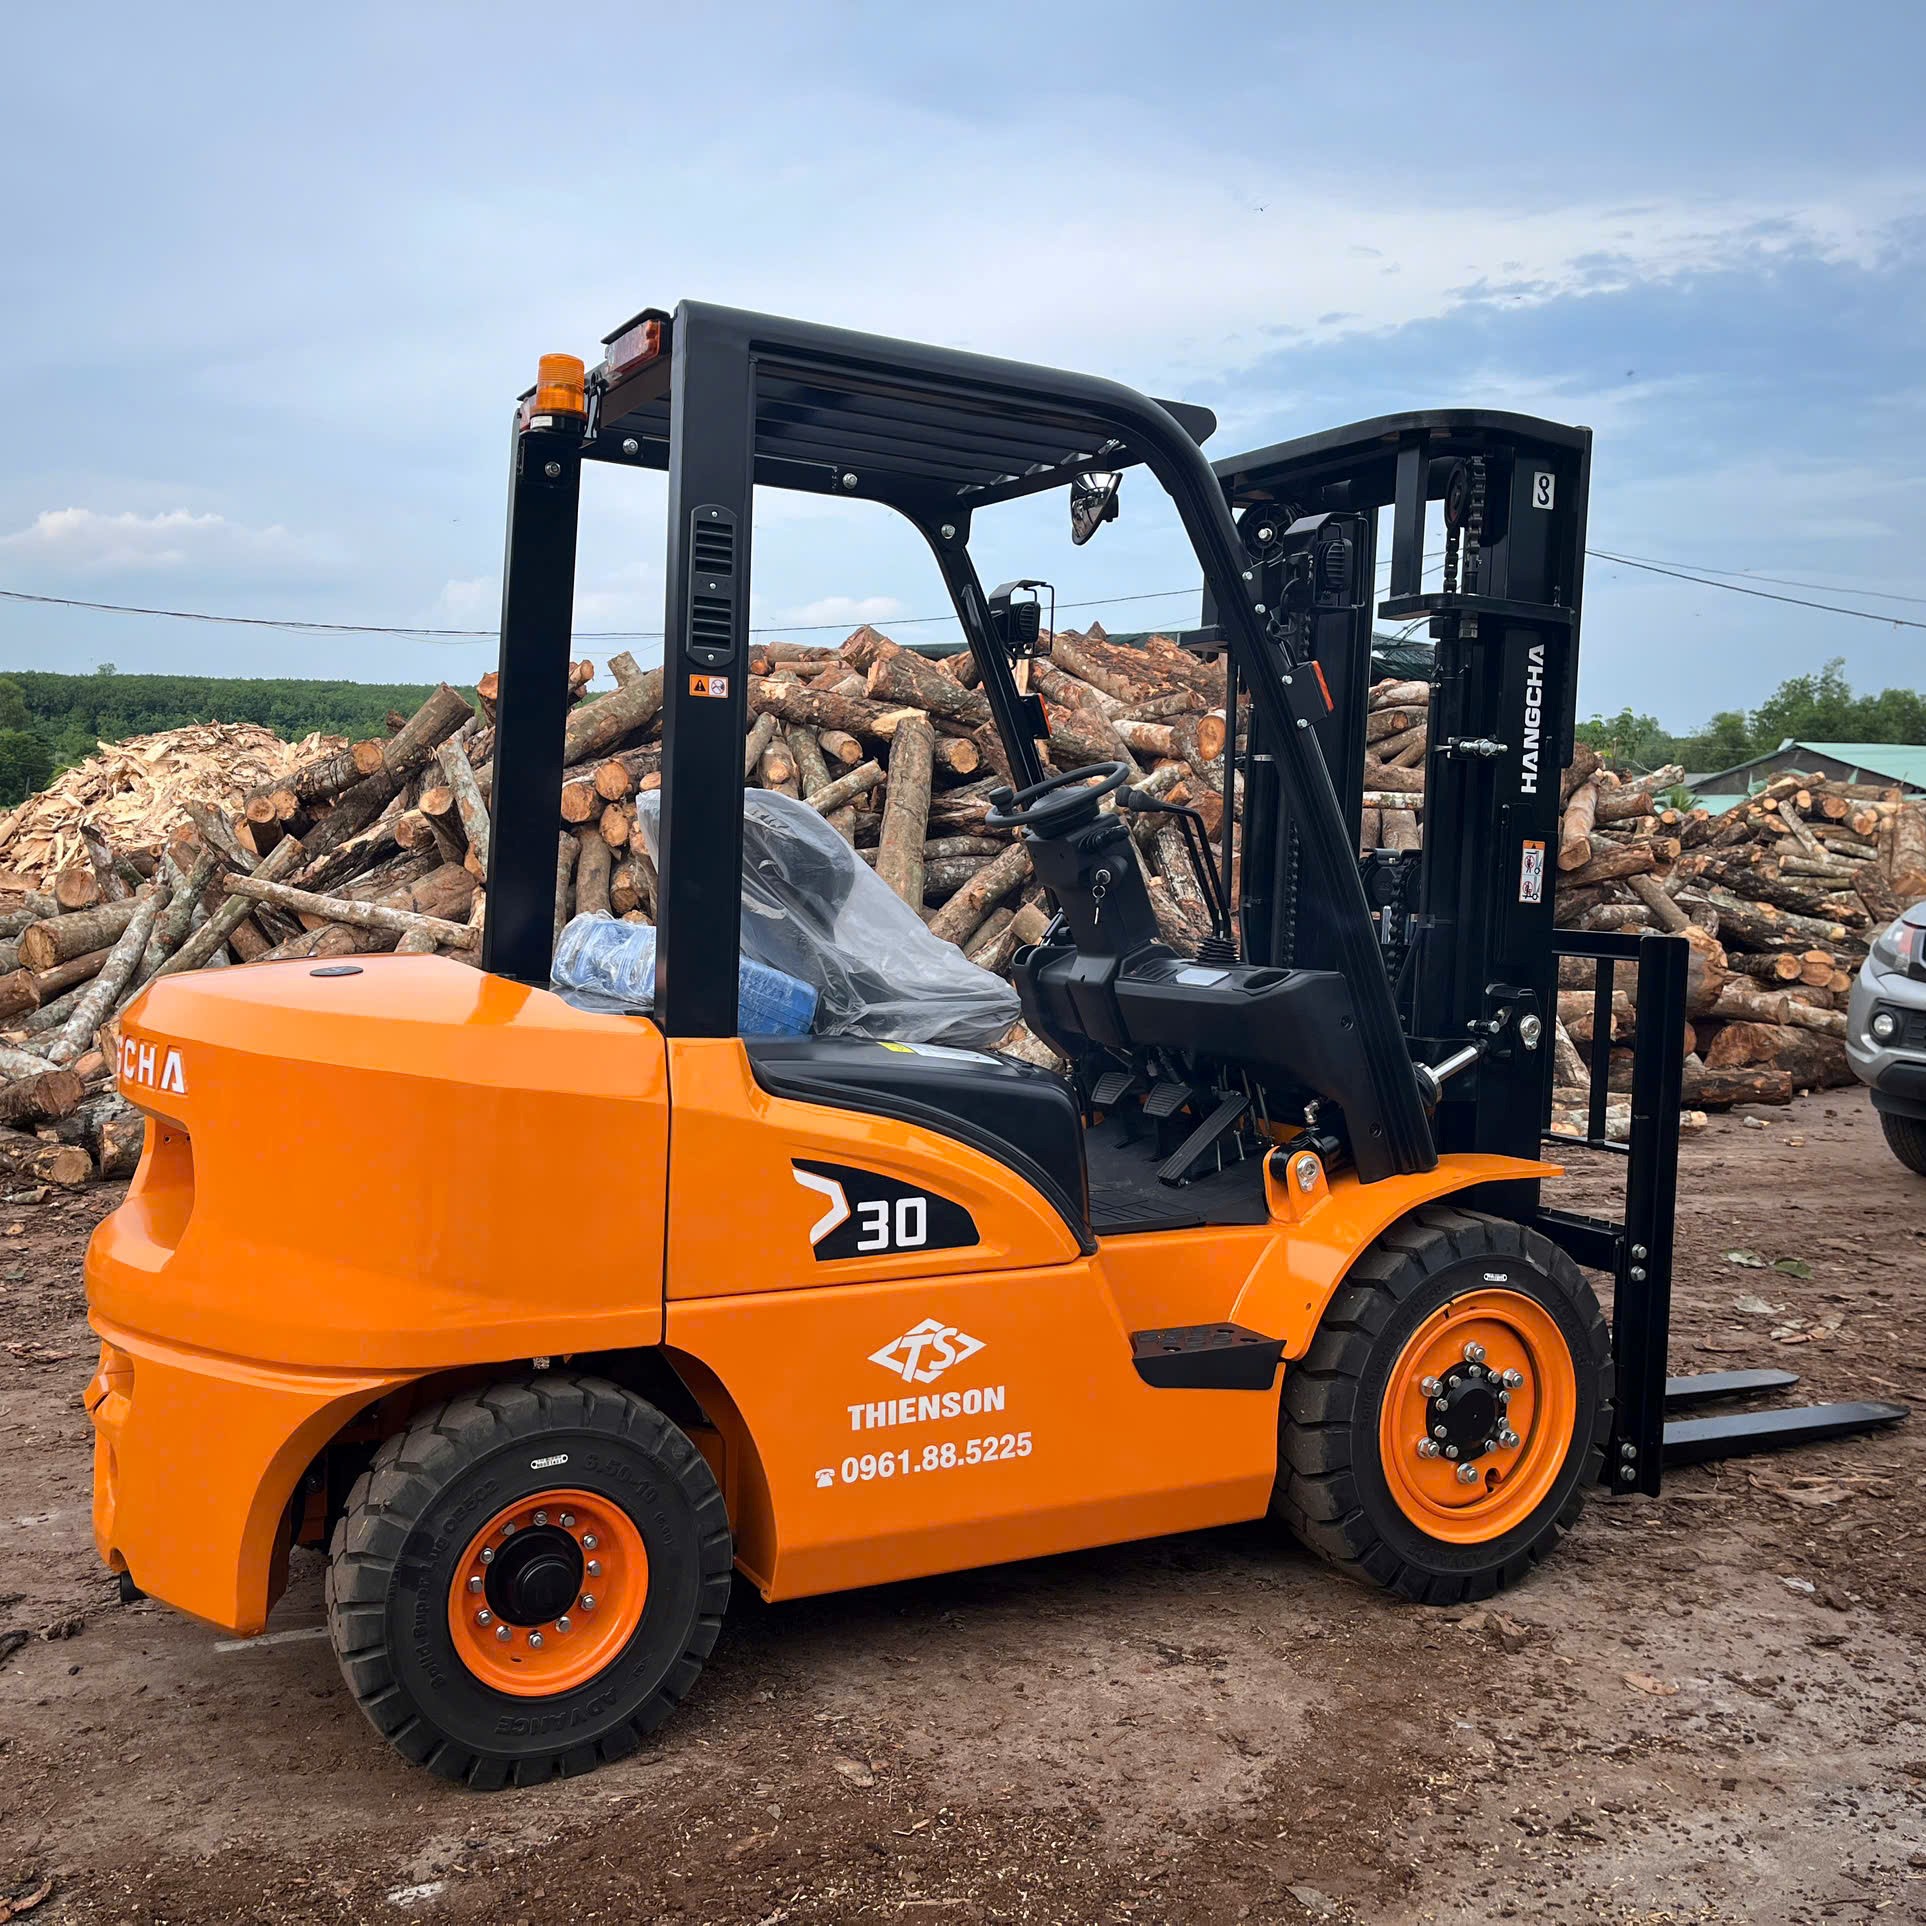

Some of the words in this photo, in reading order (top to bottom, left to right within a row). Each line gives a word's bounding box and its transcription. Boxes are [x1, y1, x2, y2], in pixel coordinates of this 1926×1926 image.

[1520, 643, 1545, 794] HANGCHA
[857, 1197, 927, 1251] 30
[847, 1385, 1006, 1431] THIENSON
[840, 1431, 1033, 1483] 0961.88.5225
[495, 1686, 616, 1736] ADVANCE
